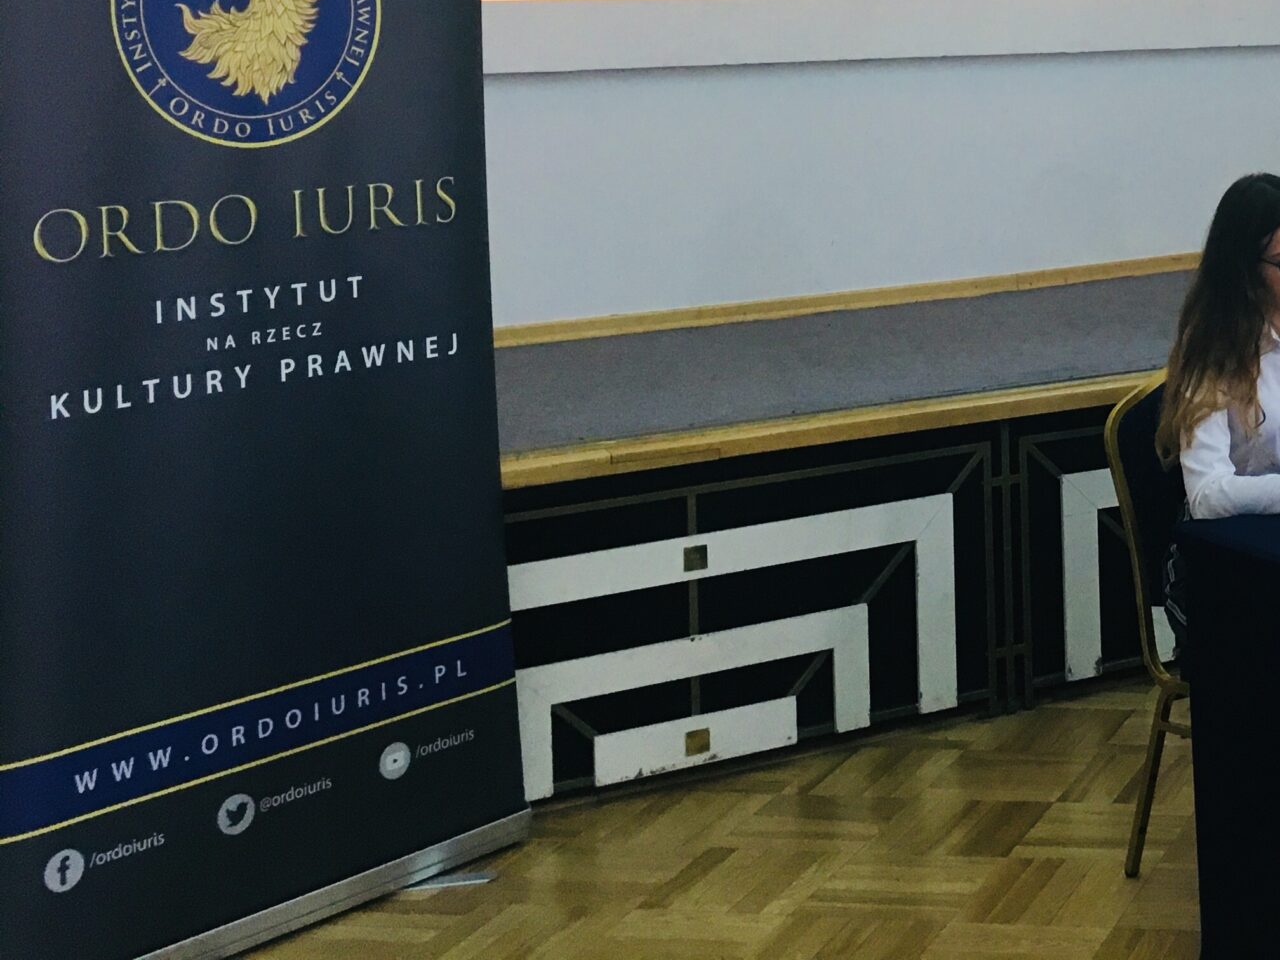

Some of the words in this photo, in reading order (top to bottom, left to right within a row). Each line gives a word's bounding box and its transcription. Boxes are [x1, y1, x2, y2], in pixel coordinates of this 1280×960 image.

[169, 96, 251, 138] ORDO
[268, 90, 337, 136] IURIS
[33, 194, 259, 263] ORDO
[292, 176, 457, 238] IURIS
[155, 275, 363, 324] INSTYTUT
[206, 334, 236, 351] NA
[251, 322, 323, 345] RZECZ
[50, 364, 252, 420] KULTURY
[280, 332, 459, 382] PRAWNEJ
[74, 659, 468, 794] WWW.ORDOIURIS.PL
[415, 727, 475, 759] /ordoiuris
[259, 776, 332, 813] @ordoiuris
[89, 831, 165, 869] /ordoiuris
